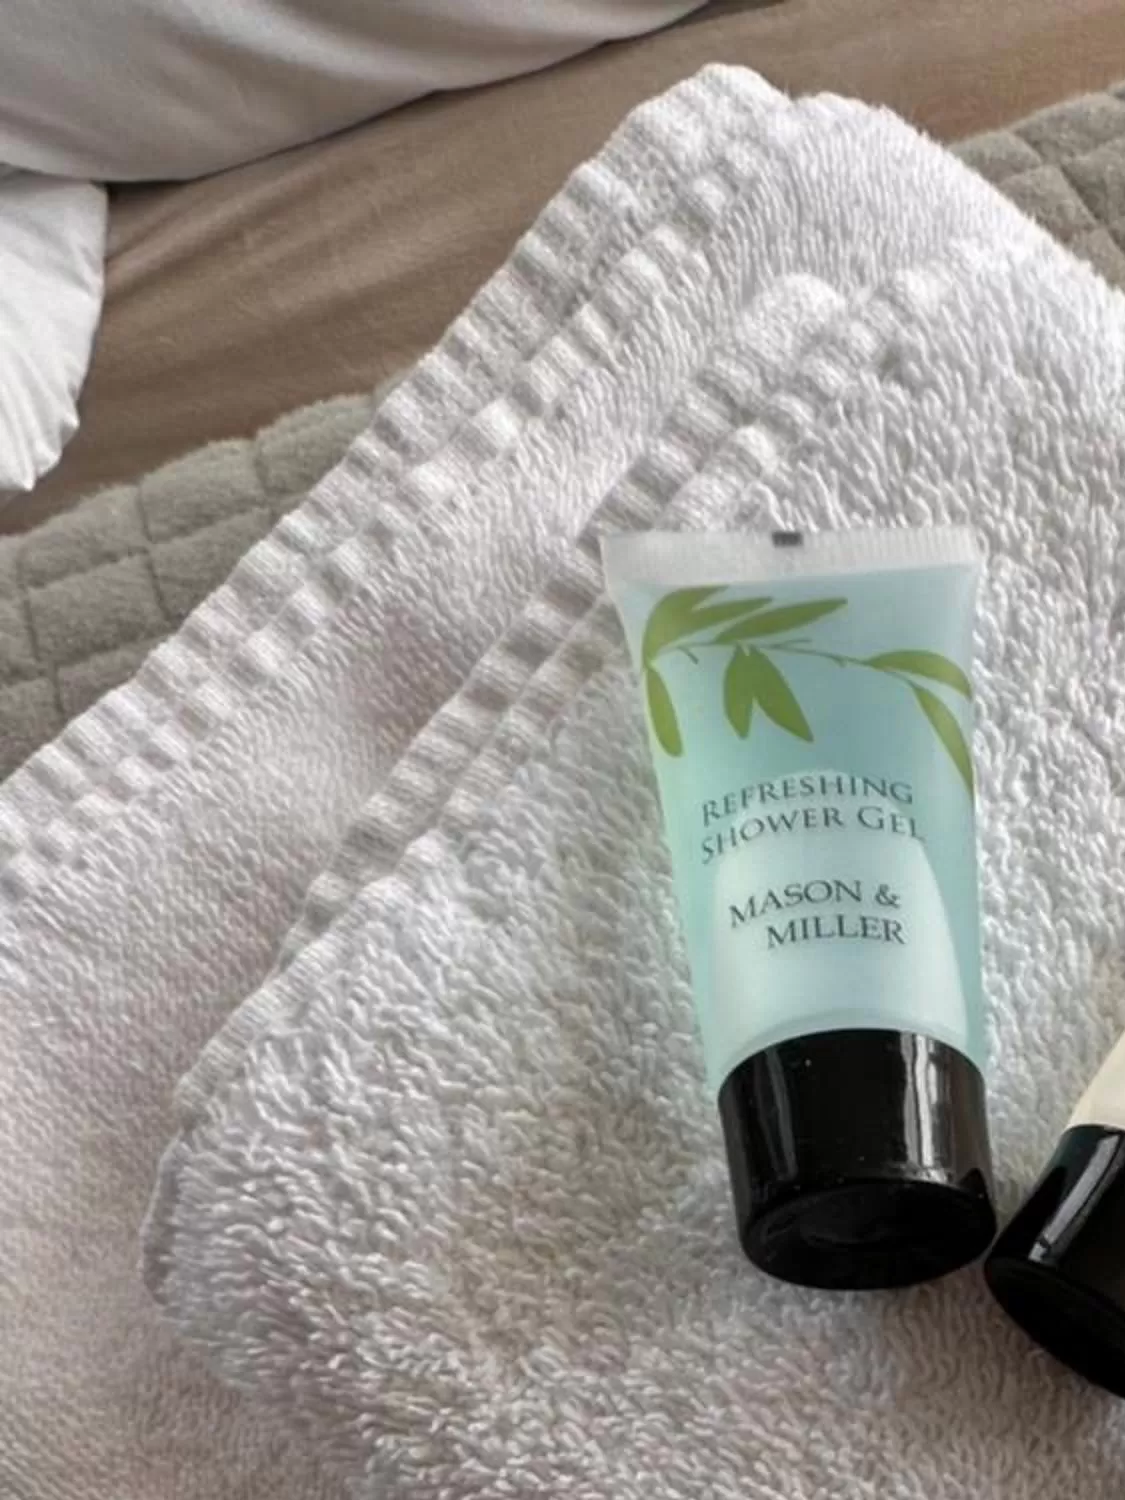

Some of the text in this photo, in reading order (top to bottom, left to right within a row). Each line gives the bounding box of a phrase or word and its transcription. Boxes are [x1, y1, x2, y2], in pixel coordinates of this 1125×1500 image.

[700, 774, 914, 827] REFRESHING
[701, 805, 927, 865] SHOWER GEL
[728, 879, 900, 929] MASON &
[766, 914, 906, 949] MILLER
